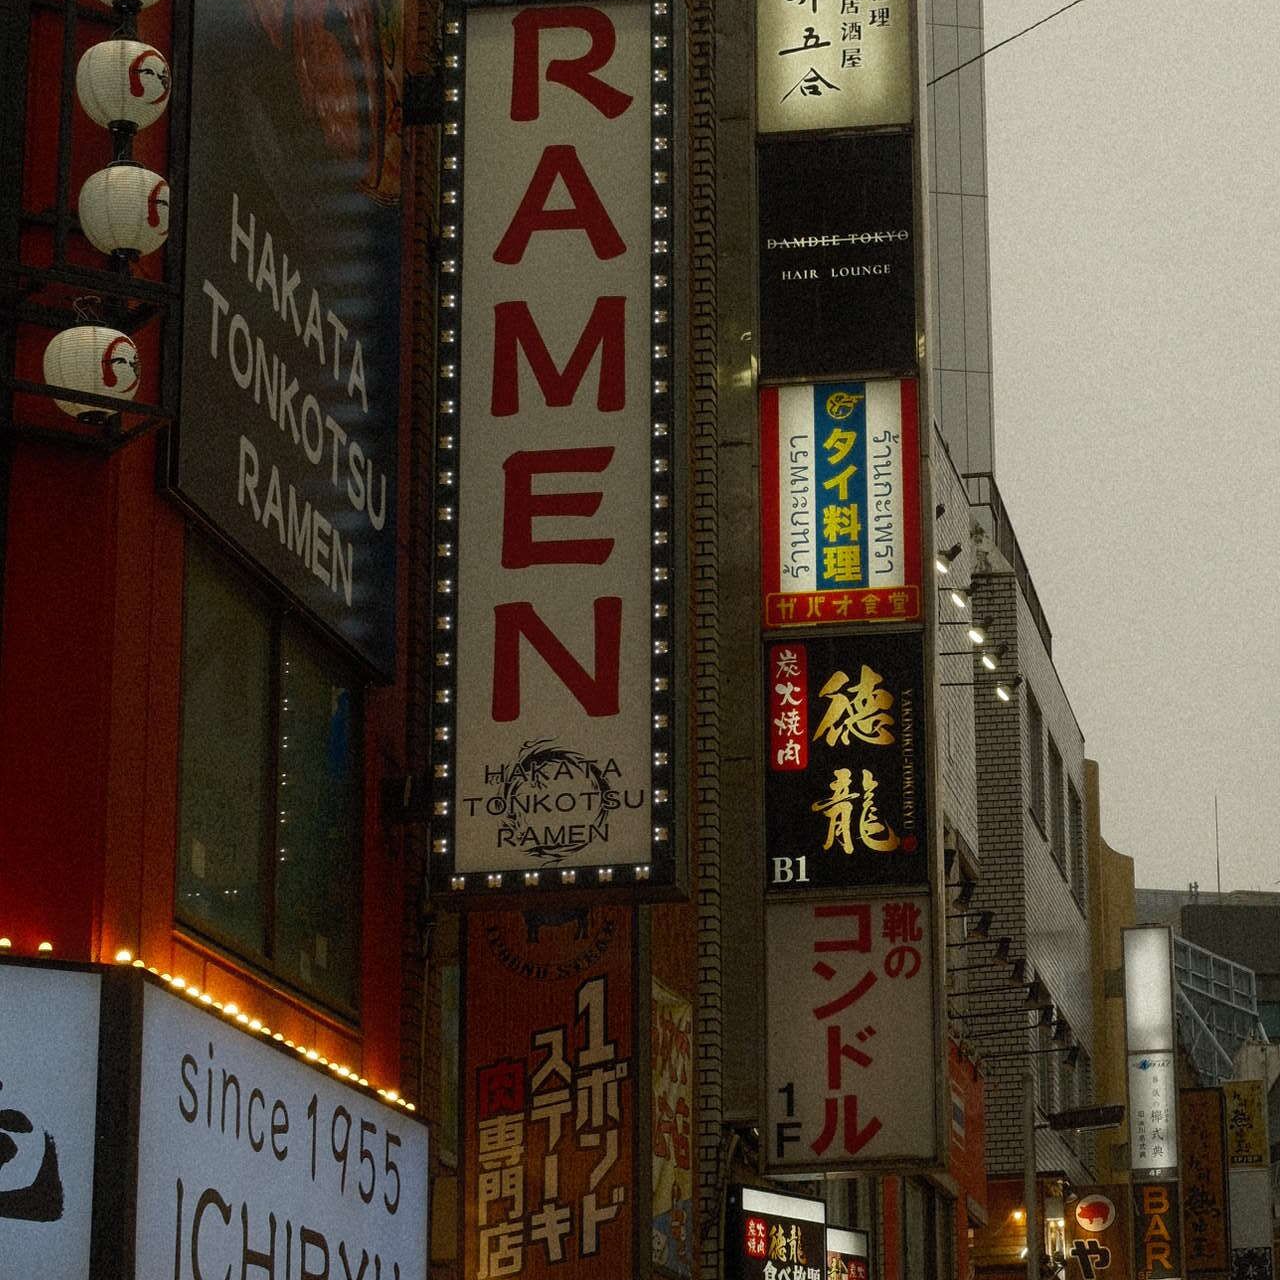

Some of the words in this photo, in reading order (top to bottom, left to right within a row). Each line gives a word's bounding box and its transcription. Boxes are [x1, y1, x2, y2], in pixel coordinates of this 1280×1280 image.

[230, 193, 368, 413] HAKATA
[782, 268, 818, 280] HAIR
[831, 264, 891, 277] LOUNGE
[203, 280, 386, 530] TONKOTSU
[490, 5, 634, 721] RAMEN
[238, 435, 352, 607] RAMEN
[822, 428, 862, 582] タイ料理
[776, 591, 909, 621] ガパオ食堂
[774, 649, 804, 766] 炭火焼肉
[463, 790, 644, 816] TONKOTSU
[485, 758, 622, 784] HAKATA
[497, 823, 608, 847] RAMEN
[772, 856, 810, 884] B1
[882, 902, 922, 979] 靴の
[811, 904, 882, 1156] コンドル
[179, 1043, 290, 1161] since
[306, 1092, 403, 1214] 1955
[531, 1028, 571, 1263] ステーキ
[575, 976, 628, 1255] 1ポンド
[777, 1082, 801, 1157] 1F
[1143, 1187, 1173, 1270] BAR
